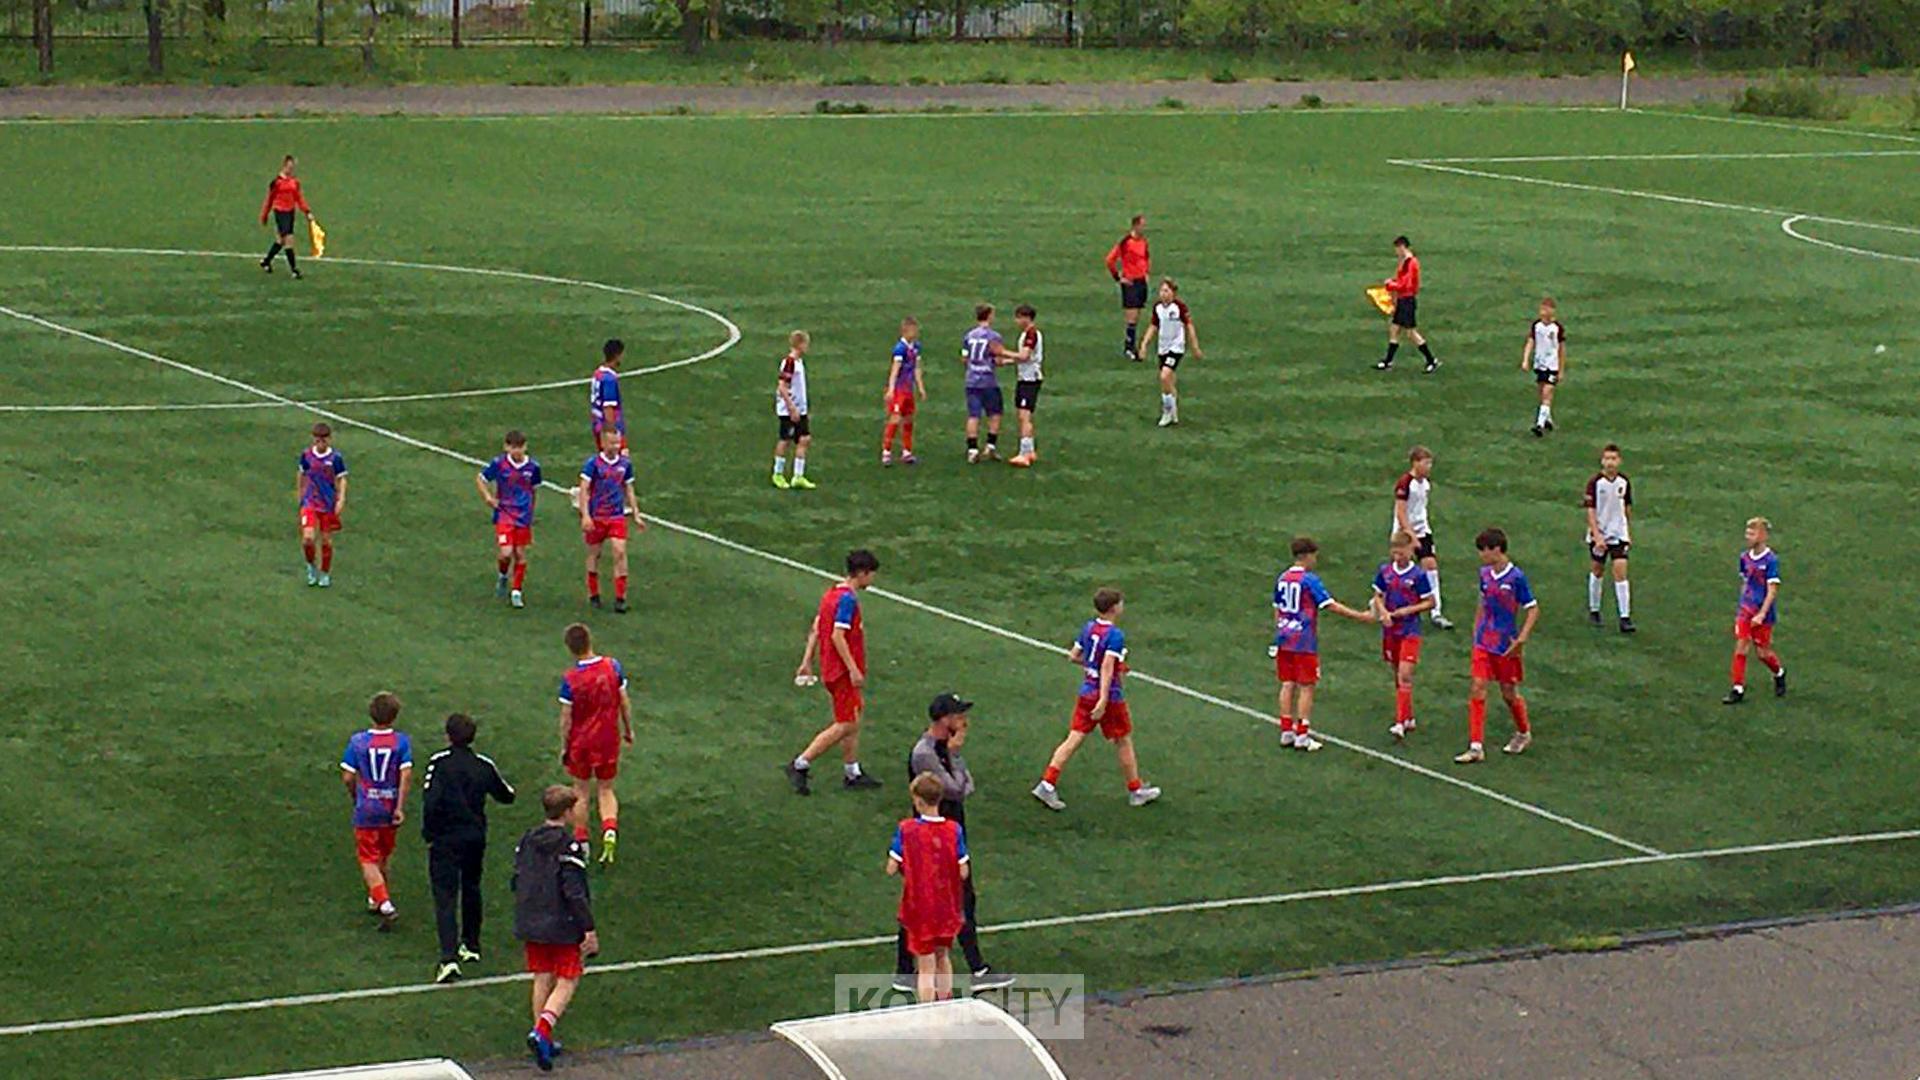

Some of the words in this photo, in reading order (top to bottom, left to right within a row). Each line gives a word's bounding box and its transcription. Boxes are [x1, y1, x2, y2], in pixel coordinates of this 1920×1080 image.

[968, 338, 988, 360] 77
[1277, 580, 1301, 613] 30
[368, 747, 391, 781] 17
